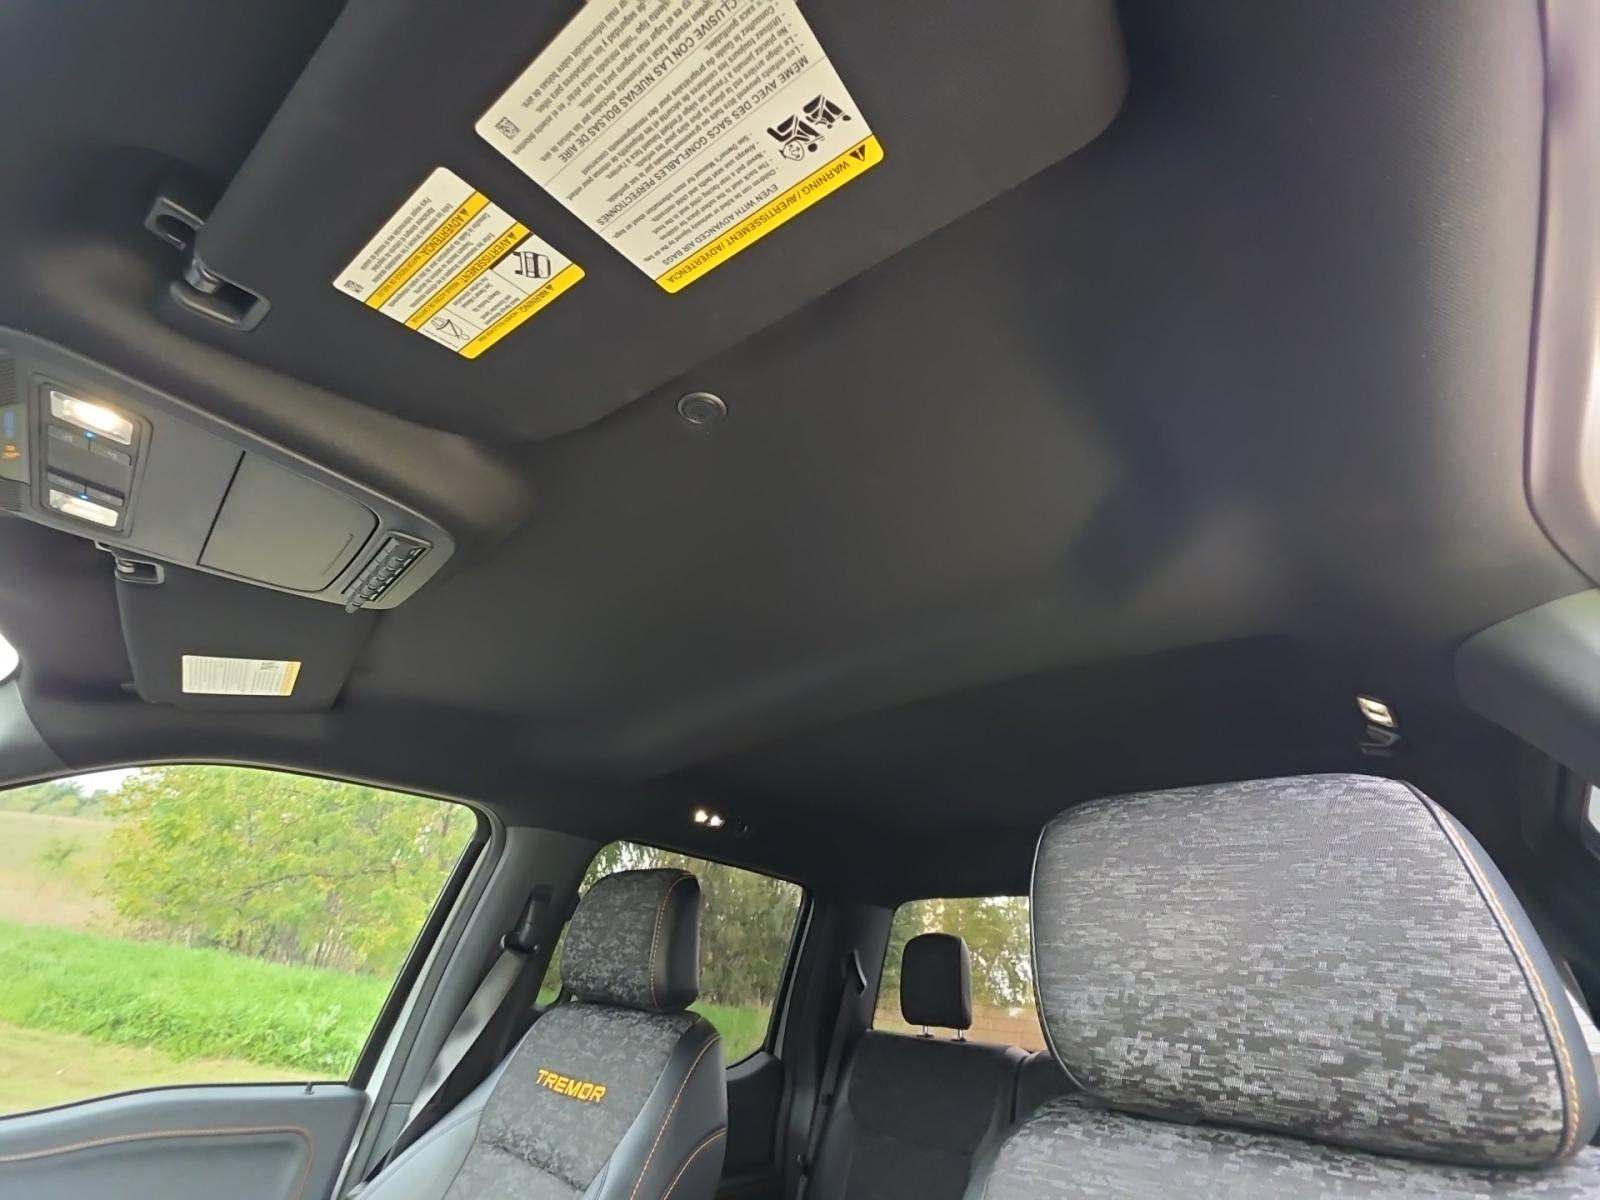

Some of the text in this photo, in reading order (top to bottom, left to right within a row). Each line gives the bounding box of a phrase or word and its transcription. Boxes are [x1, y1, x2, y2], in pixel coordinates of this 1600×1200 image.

[670, 34, 696, 60] CON
[651, 54, 674, 77] LAS
[618, 72, 655, 108] NUEVAS
[750, 78, 779, 104] AVEC
[586, 103, 622, 137] BOLSAS
[730, 99, 752, 120] DES
[575, 132, 590, 147] DE
[705, 115, 732, 139] SACS
[557, 143, 579, 163] AIRE
[652, 134, 708, 181] GONFLABLES
[800, 159, 850, 195] WARNING
[661, 183, 778, 265] EVEN WITH ADVANCED AIR BAGS
[536, 1069, 607, 1103] TREMOR
